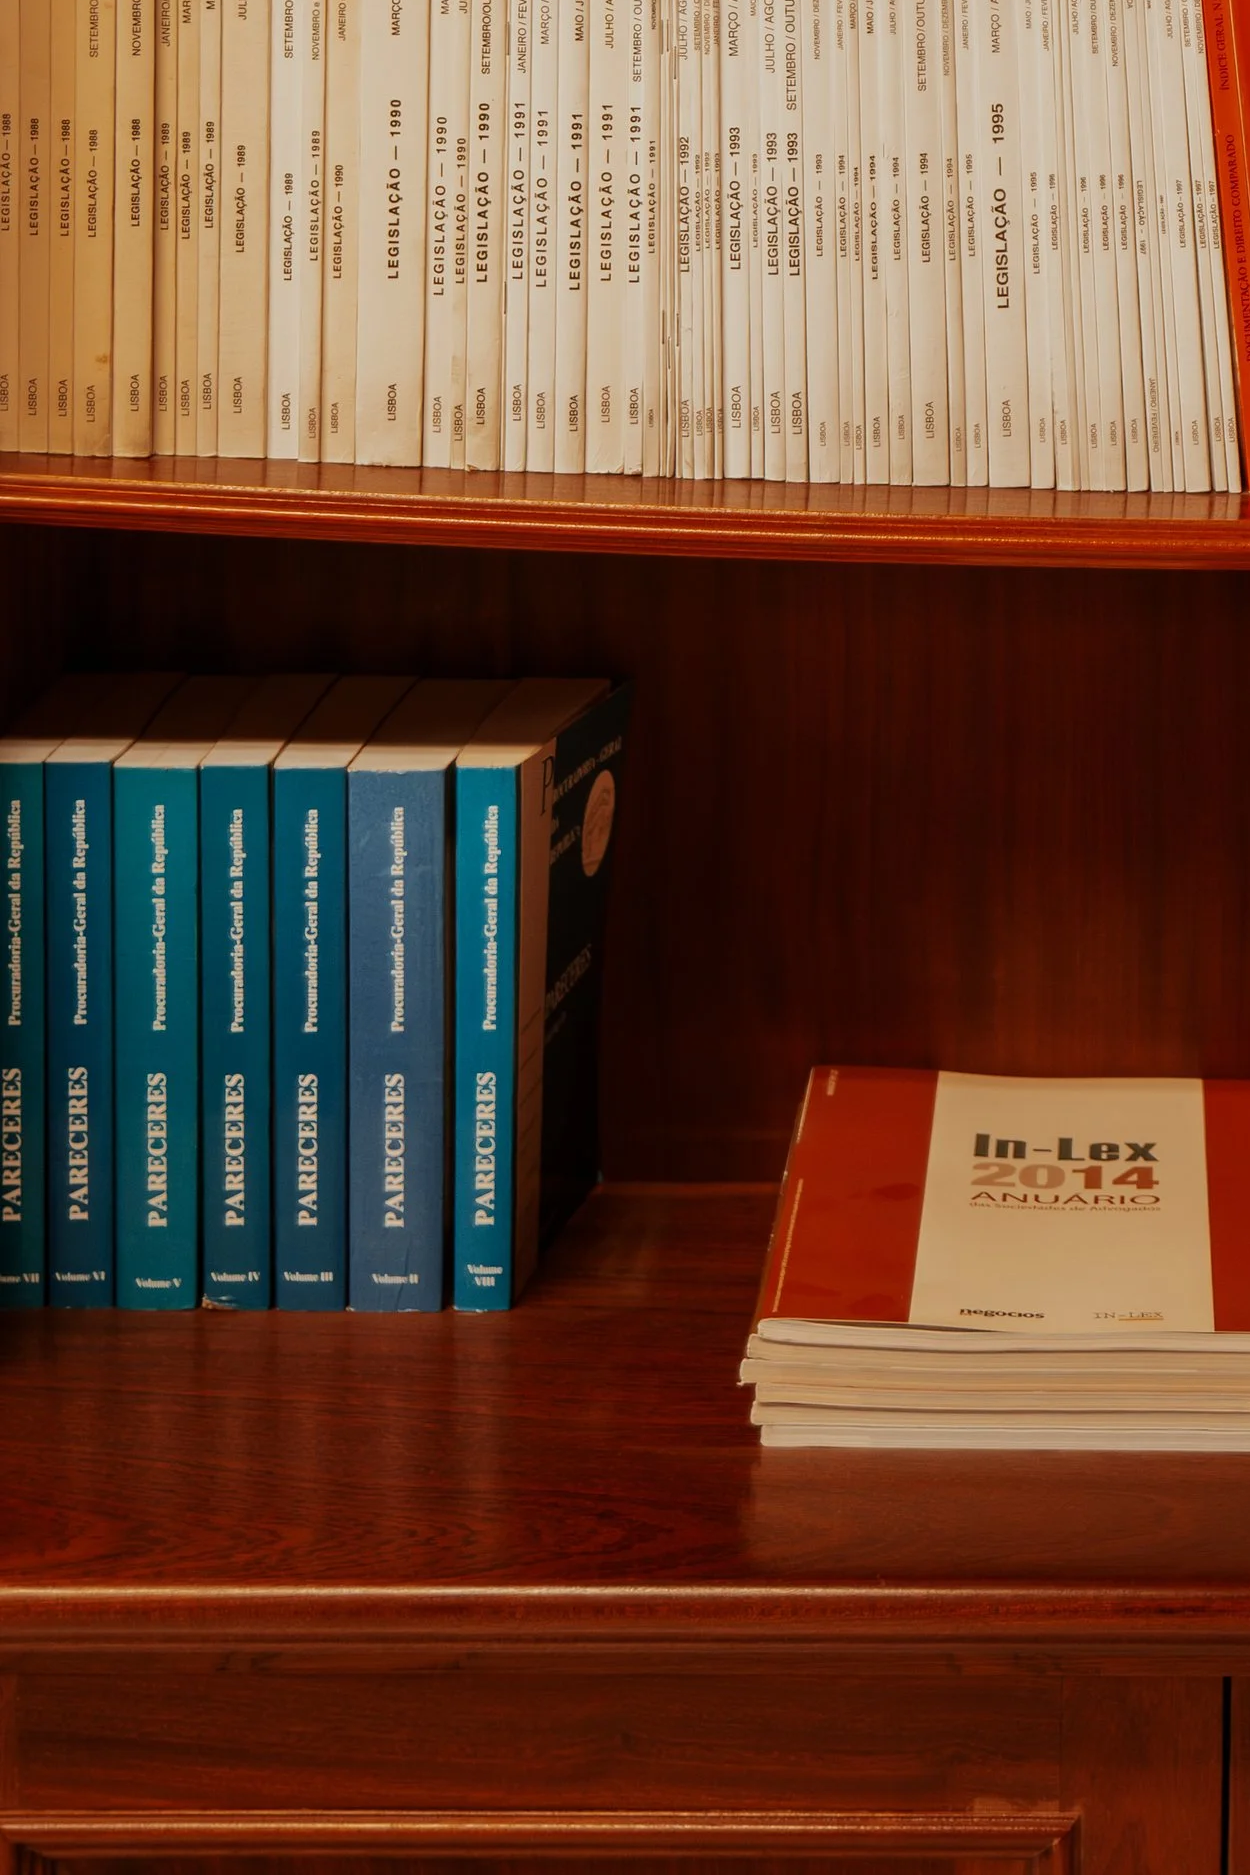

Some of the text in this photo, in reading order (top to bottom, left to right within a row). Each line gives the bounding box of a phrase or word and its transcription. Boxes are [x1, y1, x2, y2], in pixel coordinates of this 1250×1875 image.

[574, 13, 584, 42] MAIO
[727, 11, 741, 57] MARÇO
[989, 13, 1002, 53] MARÇO
[1213, 13, 1230, 91] ÍNDICE GERAL
[784, 42, 797, 111] SETEMBRO
[130, 118, 141, 141] 1988
[389, 98, 401, 137] 1990
[477, 102, 490, 140] 1990
[570, 113, 583, 150] 1991
[990, 103, 1004, 143] 1995
[236, 144, 246, 167] 1989
[728, 126, 740, 157] 1993
[786, 132, 798, 162] 1993
[918, 152, 929, 174] 1994
[129, 158, 142, 227] LEGISLAÇÃO
[283, 172, 293, 195] 1989
[1224, 134, 1241, 207] COMPARADO
[234, 187, 247, 253] LEGISLAÇÃO
[386, 168, 402, 279] LEGISLAÇÃO
[474, 171, 491, 283] LEGISLAÇÃO
[567, 180, 584, 291] LEGISLAÇÃO
[726, 180, 743, 270] LEGISLAÇÃO
[785, 186, 802, 276] LEGISLAÇÃO
[918, 195, 931, 263] LEGISLAÇÃO
[1232, 208, 1245, 254] DIREITO
[281, 215, 294, 281] LEGISLAÇÃO
[991, 188, 1010, 309] LEGISLAÇÃO
[1236, 255, 1247, 264] E
[129, 373, 140, 412] LISBOA
[232, 376, 242, 414] LISBOA
[280, 392, 291, 430] LISBOA
[386, 383, 397, 421] LISBOA
[475, 387, 486, 425] LISBOA
[568, 394, 579, 432] LISBOA
[730, 385, 742, 429] LISBOA
[791, 391, 803, 435] LISBOA
[924, 400, 935, 439] LISBOA
[1001, 399, 1012, 437] LISBOA
[6, 799, 24, 1025] Procuradoria-Geral da República
[71, 799, 89, 1025] Procuradoria-Geral da República
[150, 804, 168, 1030] Procuradoria-Geral da República
[229, 808, 246, 1032] Procuradoria-Geral da República
[303, 808, 321, 1032] Procuradoria-Geral da República
[390, 806, 407, 1032] Procuradoria-Geral da República
[482, 804, 501, 1030] Procuradoria-Geral da República
[1, 1068, 22, 1221] PARECERES
[67, 1067, 88, 1220] PARECERES
[146, 1072, 167, 1226] PARECERES
[224, 1073, 244, 1225] PARECERES
[297, 1073, 318, 1225] PARECERES
[384, 1073, 404, 1227] PARECERES
[474, 1072, 496, 1225] PARECERES
[974, 1134, 1159, 1162] In-Lex
[970, 1163, 1159, 1189] 2014
[971, 1191, 1160, 1205] ANUÁRIO
[210, 1271, 247, 1282] Volume
[283, 1271, 334, 1282] Volume III
[371, 1273, 419, 1284] Volume II
[466, 1264, 503, 1275] Volume
[474, 1276, 495, 1286] VIII
